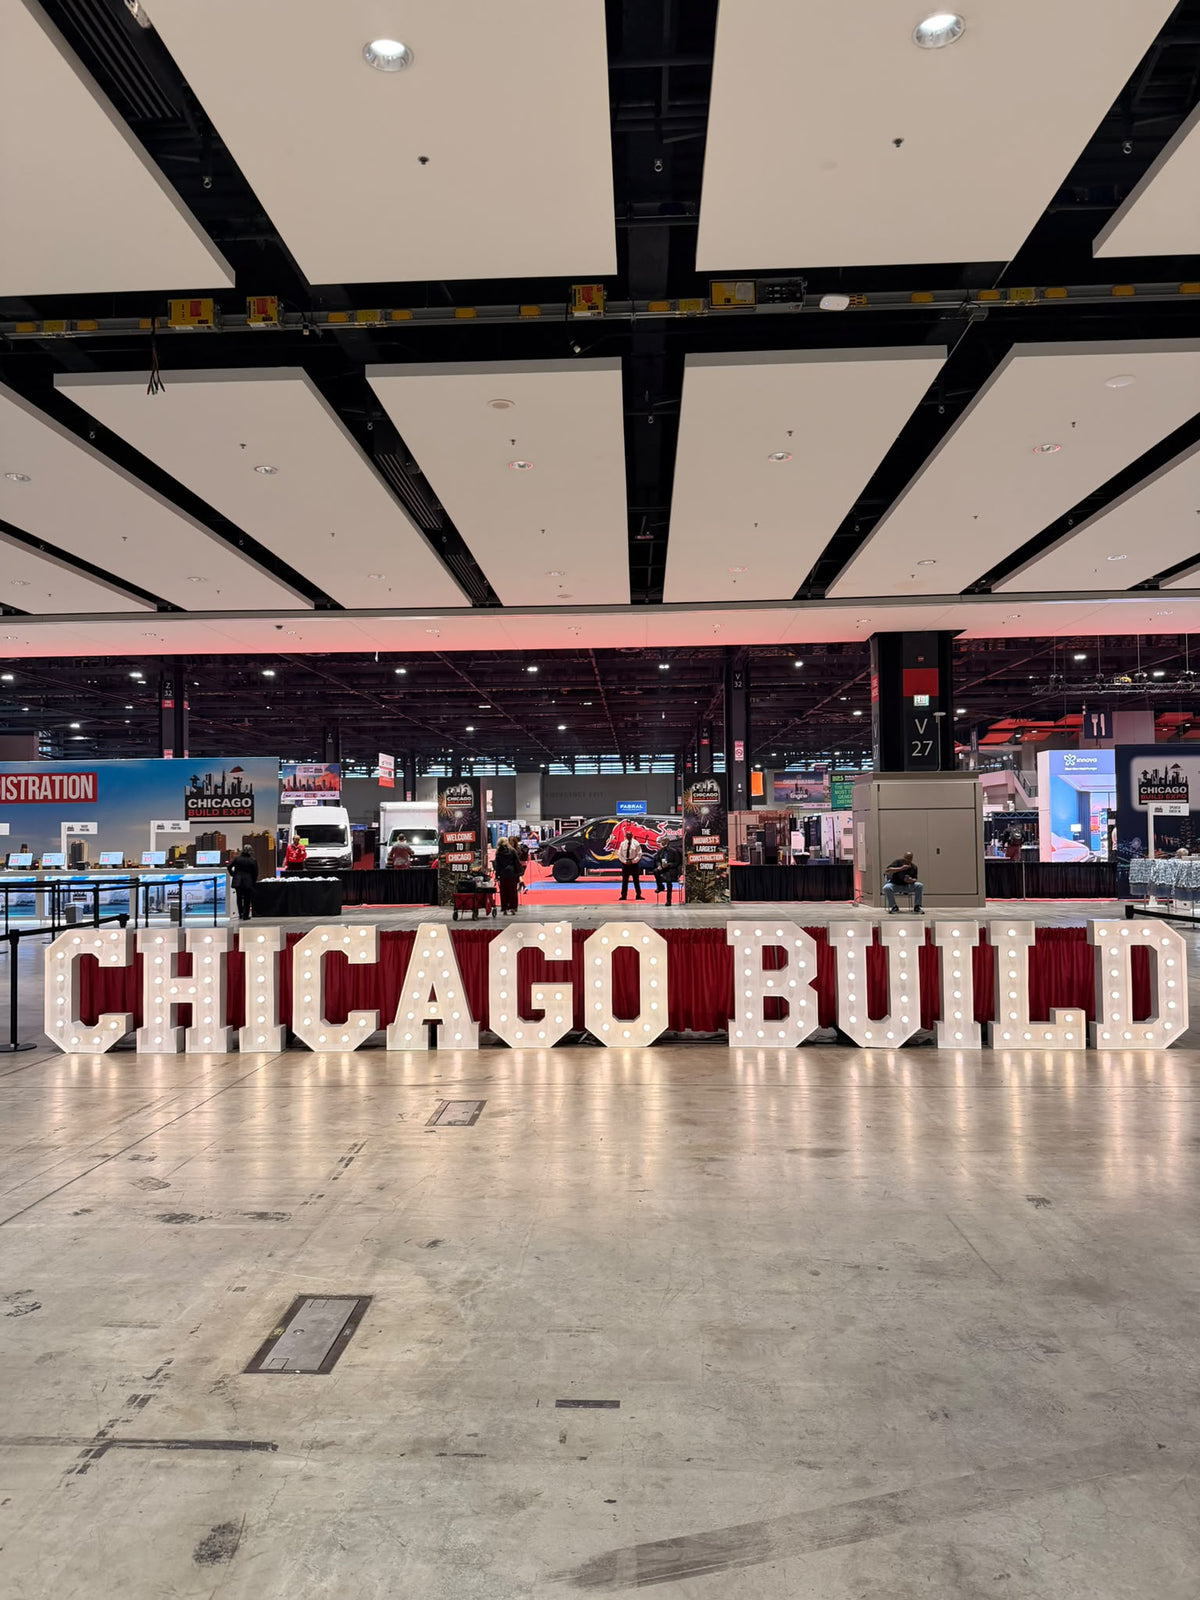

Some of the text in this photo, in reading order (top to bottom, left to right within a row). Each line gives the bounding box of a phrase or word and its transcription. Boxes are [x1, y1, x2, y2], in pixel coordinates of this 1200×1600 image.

[914, 718, 928, 735] V
[911, 740, 934, 757] 27
[0, 774, 93, 801] ISTRATION
[1140, 786, 1187, 794] CHICAGO
[188, 797, 252, 808] CHICAGO
[187, 808, 252, 816] BUILD EXPO
[701, 828, 711, 836] THE
[445, 832, 473, 842] WELCOME
[456, 843, 464, 851] TO
[695, 845, 717, 853] LARGEST
[448, 853, 472, 862] CHICAGO
[452, 864, 468, 872] BUILD
[699, 862, 714, 870] SHOW
[45, 919, 1190, 1053] CHICAGO BUILD
